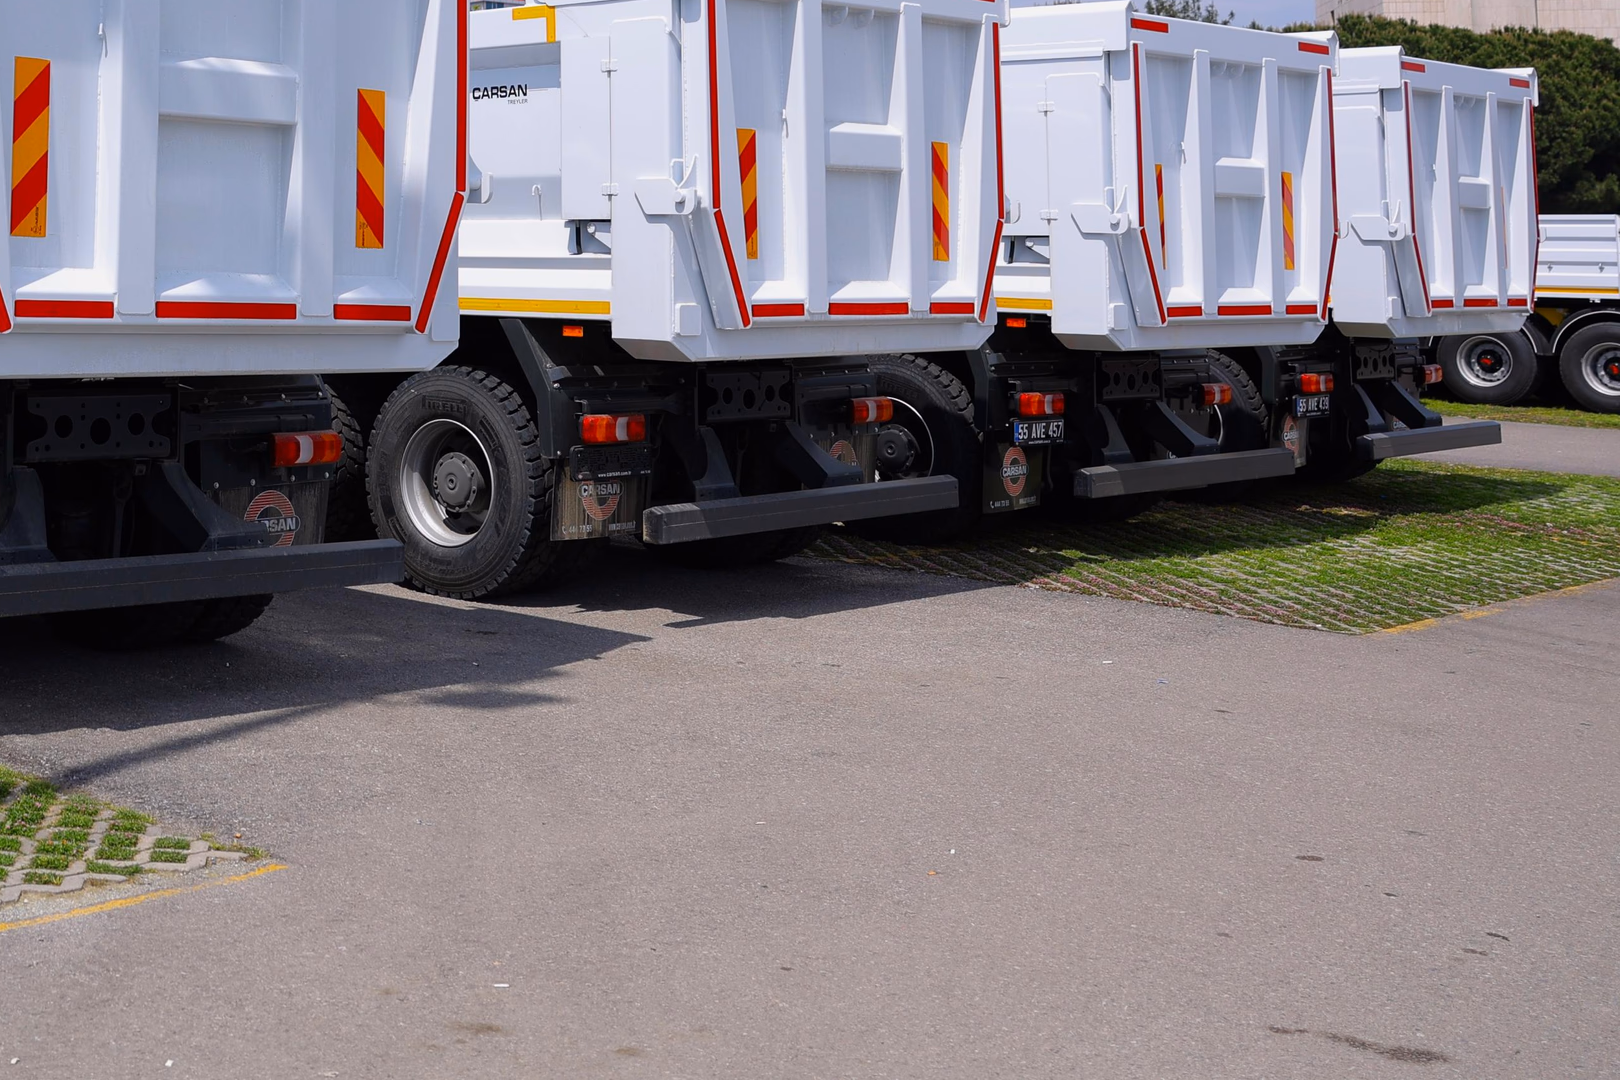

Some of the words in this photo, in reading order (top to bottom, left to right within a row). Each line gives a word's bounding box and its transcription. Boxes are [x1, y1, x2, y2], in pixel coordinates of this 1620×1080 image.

[1018, 424, 1029, 440] 55
[1031, 423, 1046, 439] AVE
[1048, 422, 1062, 438] 457
